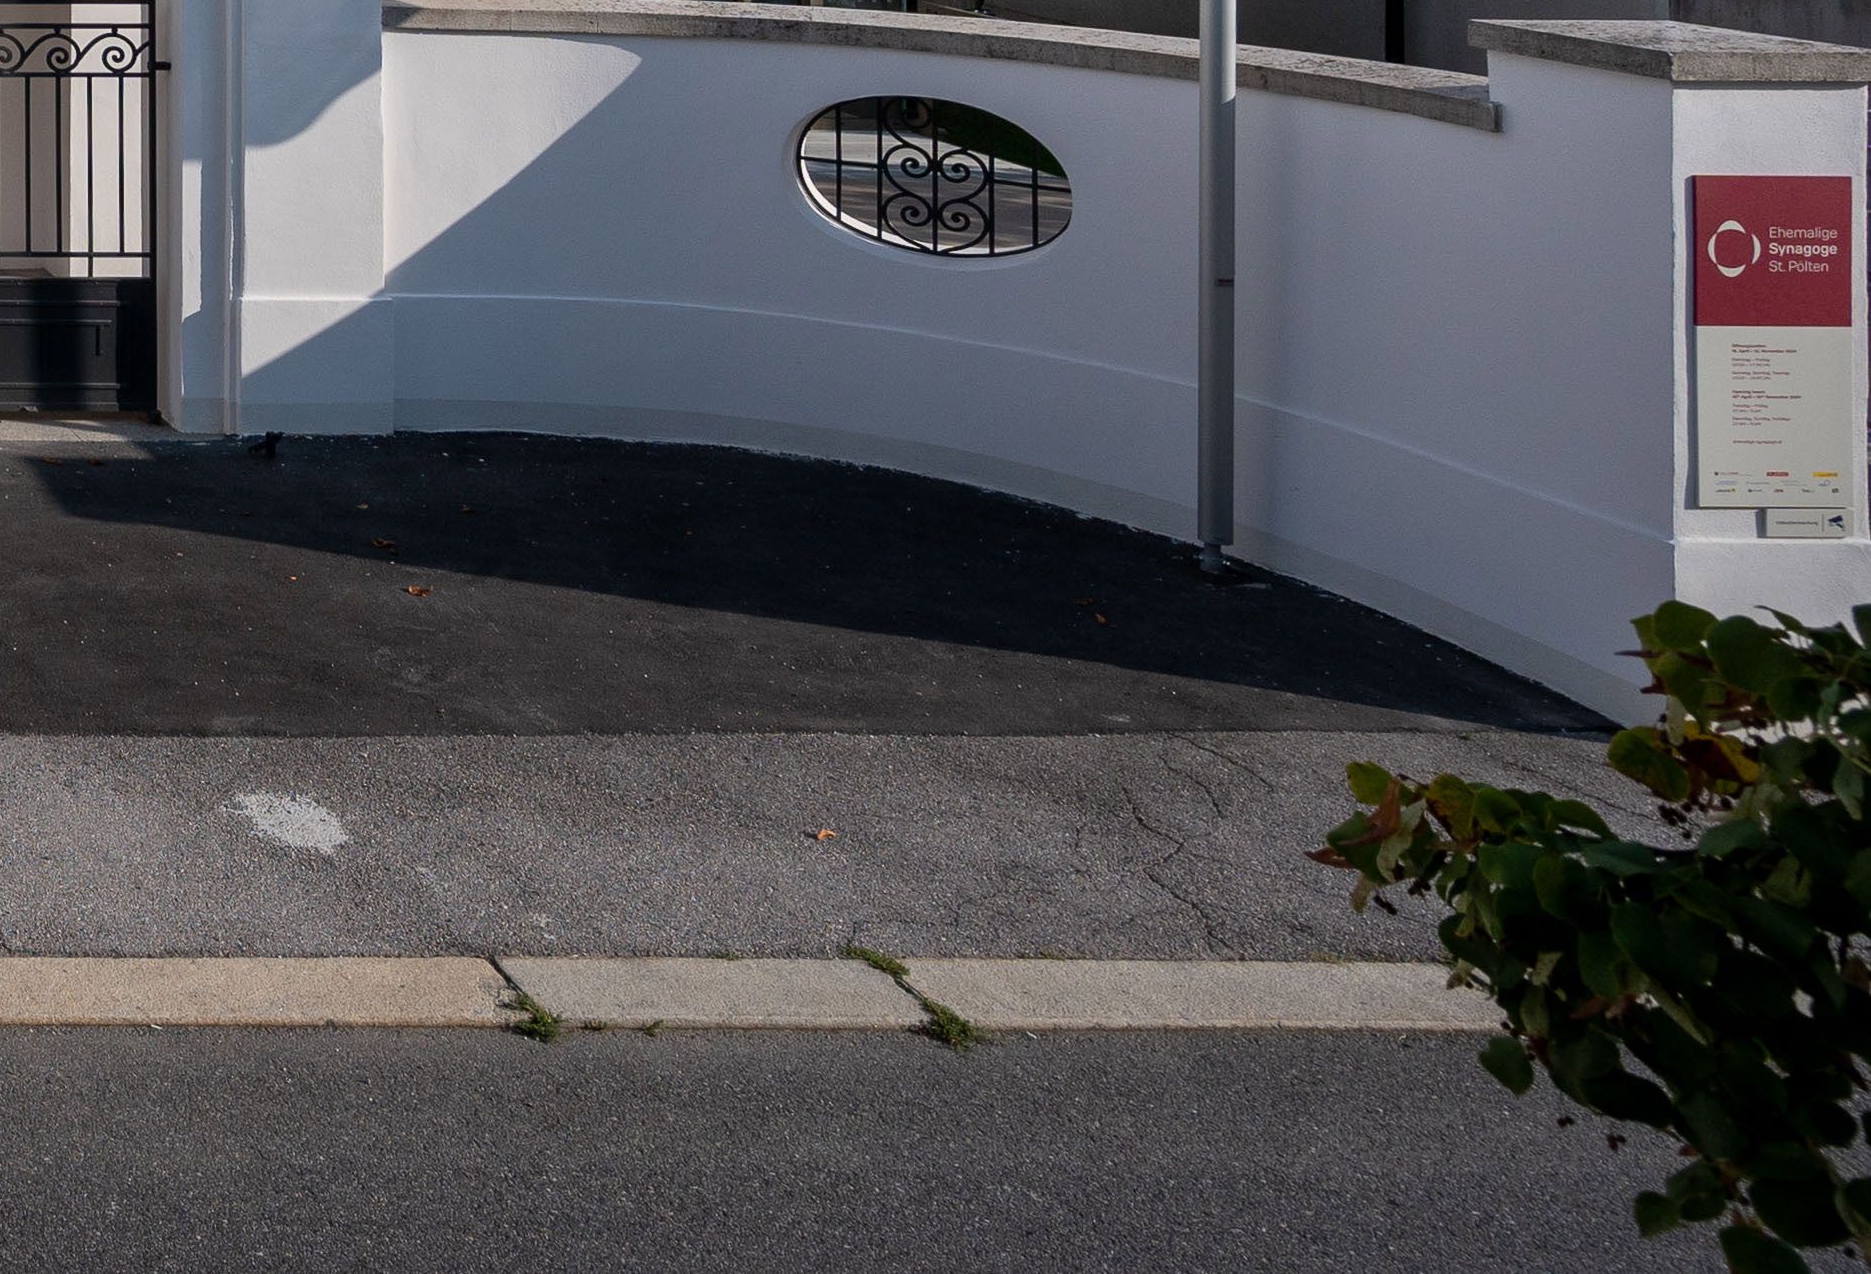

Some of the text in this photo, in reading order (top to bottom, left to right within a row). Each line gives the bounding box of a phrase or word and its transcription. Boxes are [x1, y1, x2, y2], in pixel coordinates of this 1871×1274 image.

[1769, 226, 1838, 241] Ehemalige
[1768, 242, 1838, 257] Synagoge
[1768, 259, 1829, 272] St. Pölten
